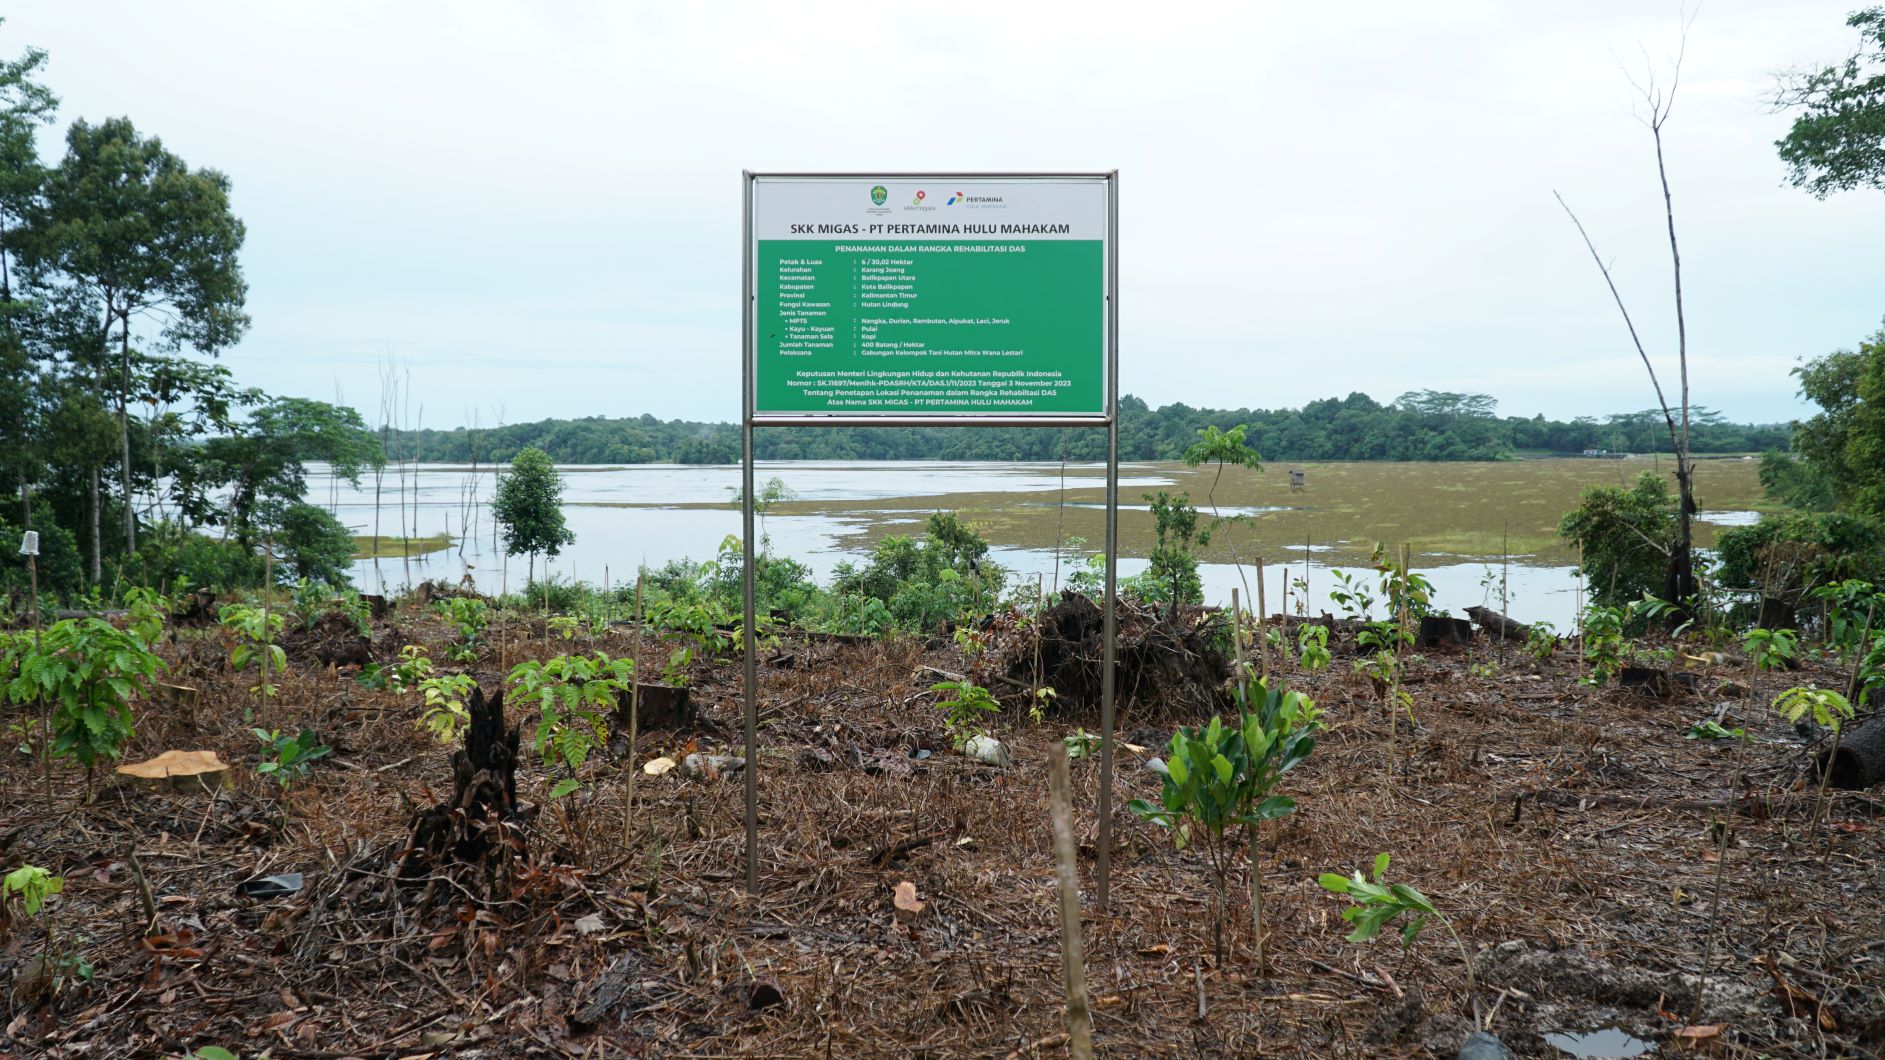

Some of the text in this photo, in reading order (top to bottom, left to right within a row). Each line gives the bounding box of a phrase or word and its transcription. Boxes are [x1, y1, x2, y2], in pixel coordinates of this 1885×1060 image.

[791, 224, 813, 233] SKK
[818, 224, 859, 233] MIGAS
[869, 224, 884, 233] PT
[888, 224, 959, 233] PERTAMINA
[964, 224, 996, 233] HULU
[1000, 224, 1070, 233] MAHAKAM
[978, 380, 1008, 388] Tanggal
